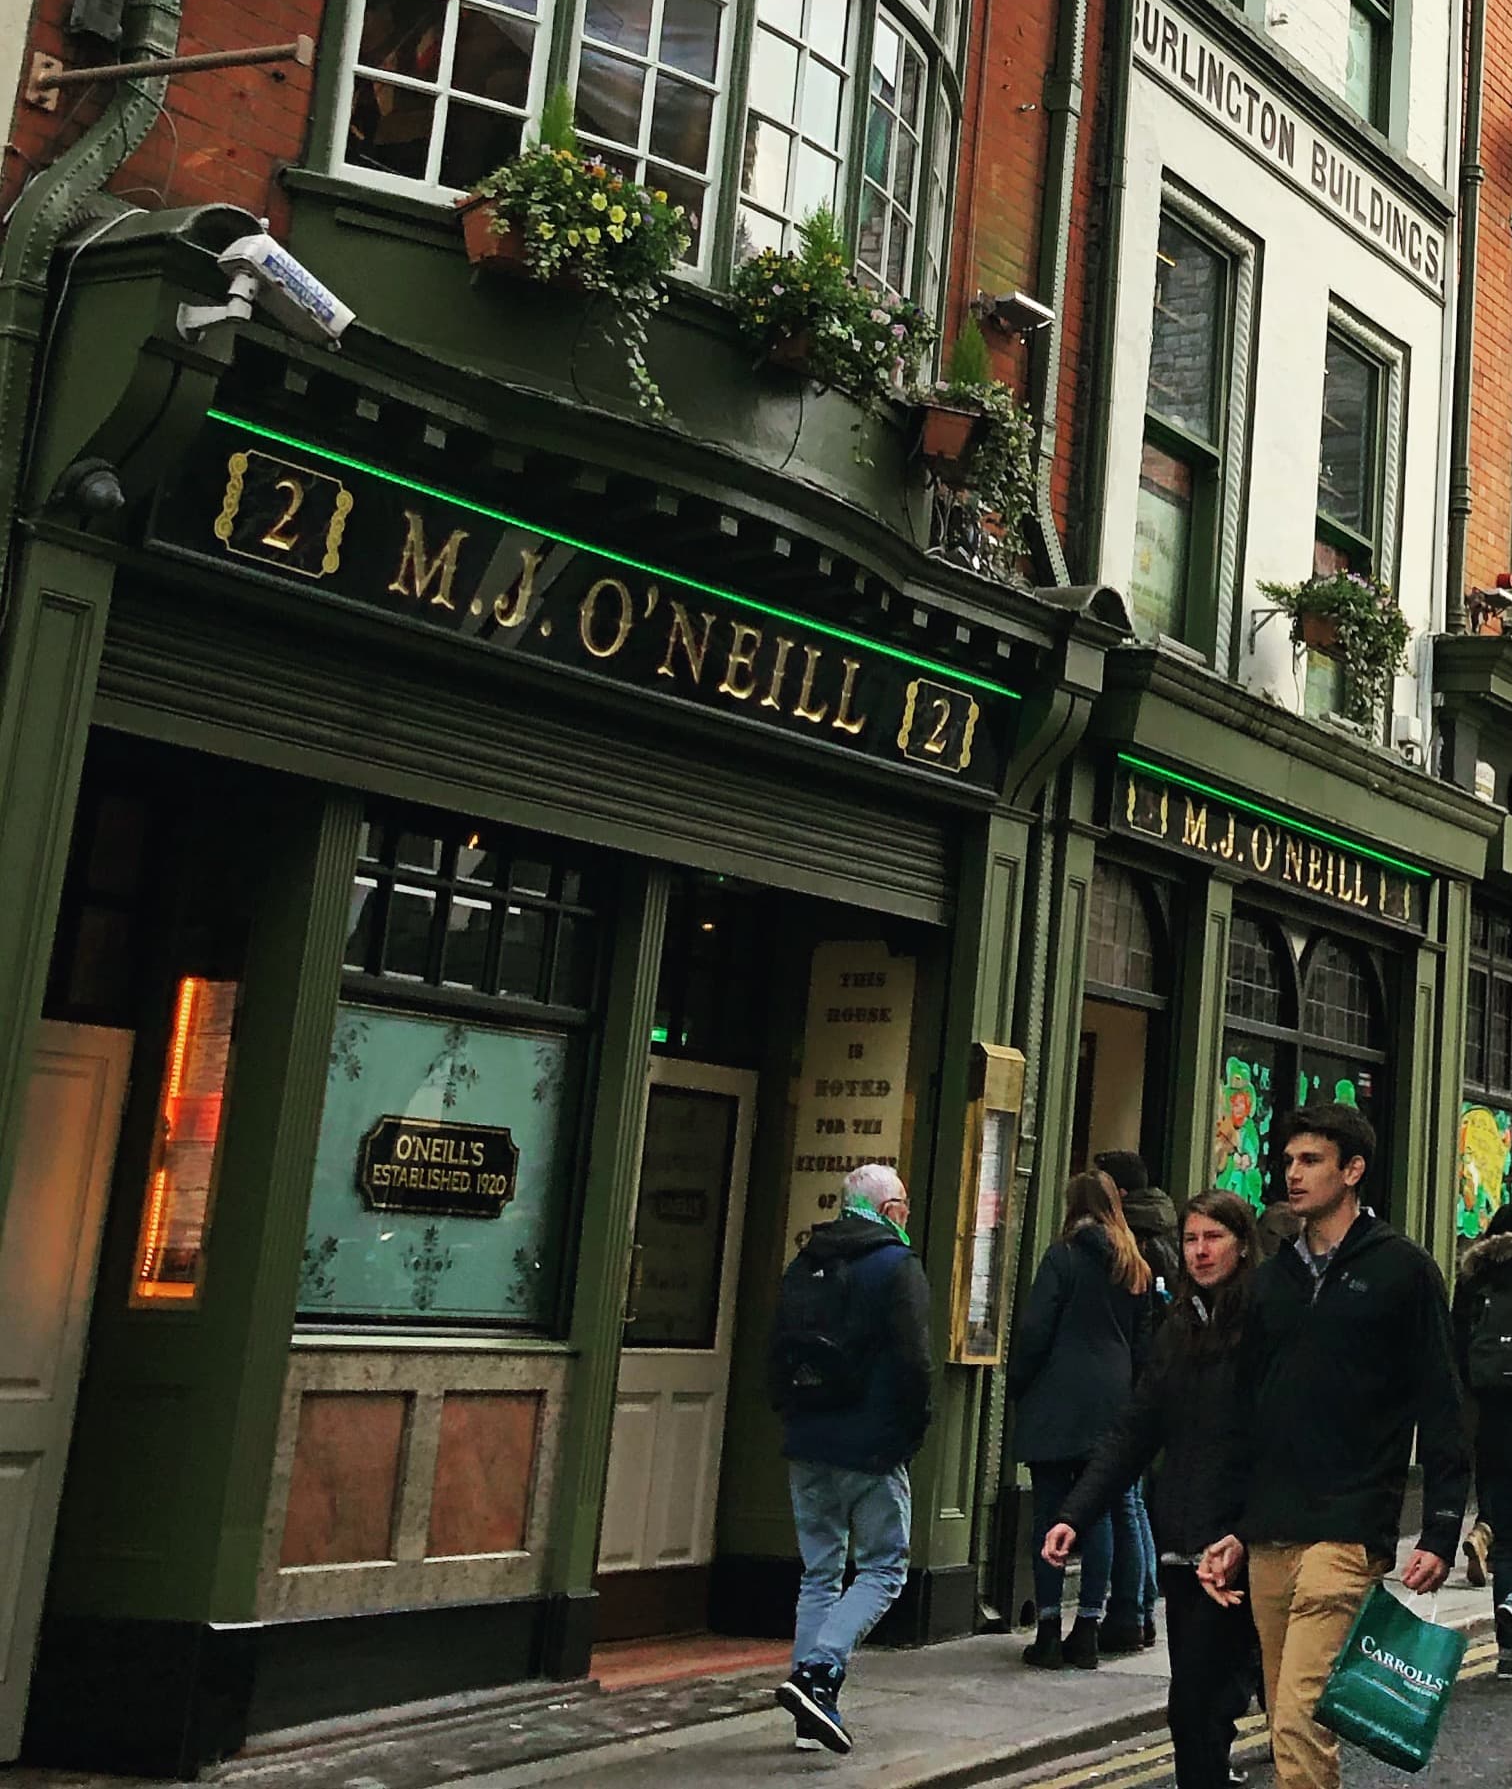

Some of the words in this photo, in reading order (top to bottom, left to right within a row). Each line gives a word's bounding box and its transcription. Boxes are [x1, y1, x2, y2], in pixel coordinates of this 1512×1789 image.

[262, 478, 304, 551] 2
[581, 578, 867, 735] O'NEILL
[924, 698, 951, 755] 2
[1251, 823, 1369, 907] O'NEILL
[840, 971, 886, 988] THIS
[826, 1007, 892, 1023] HOUSE
[815, 1079, 891, 1098] NOTED
[395, 1135, 485, 1166] O'NEILL'S
[476, 1173, 507, 1195] 1920
[1361, 1636, 1443, 1690] CARROLLS
